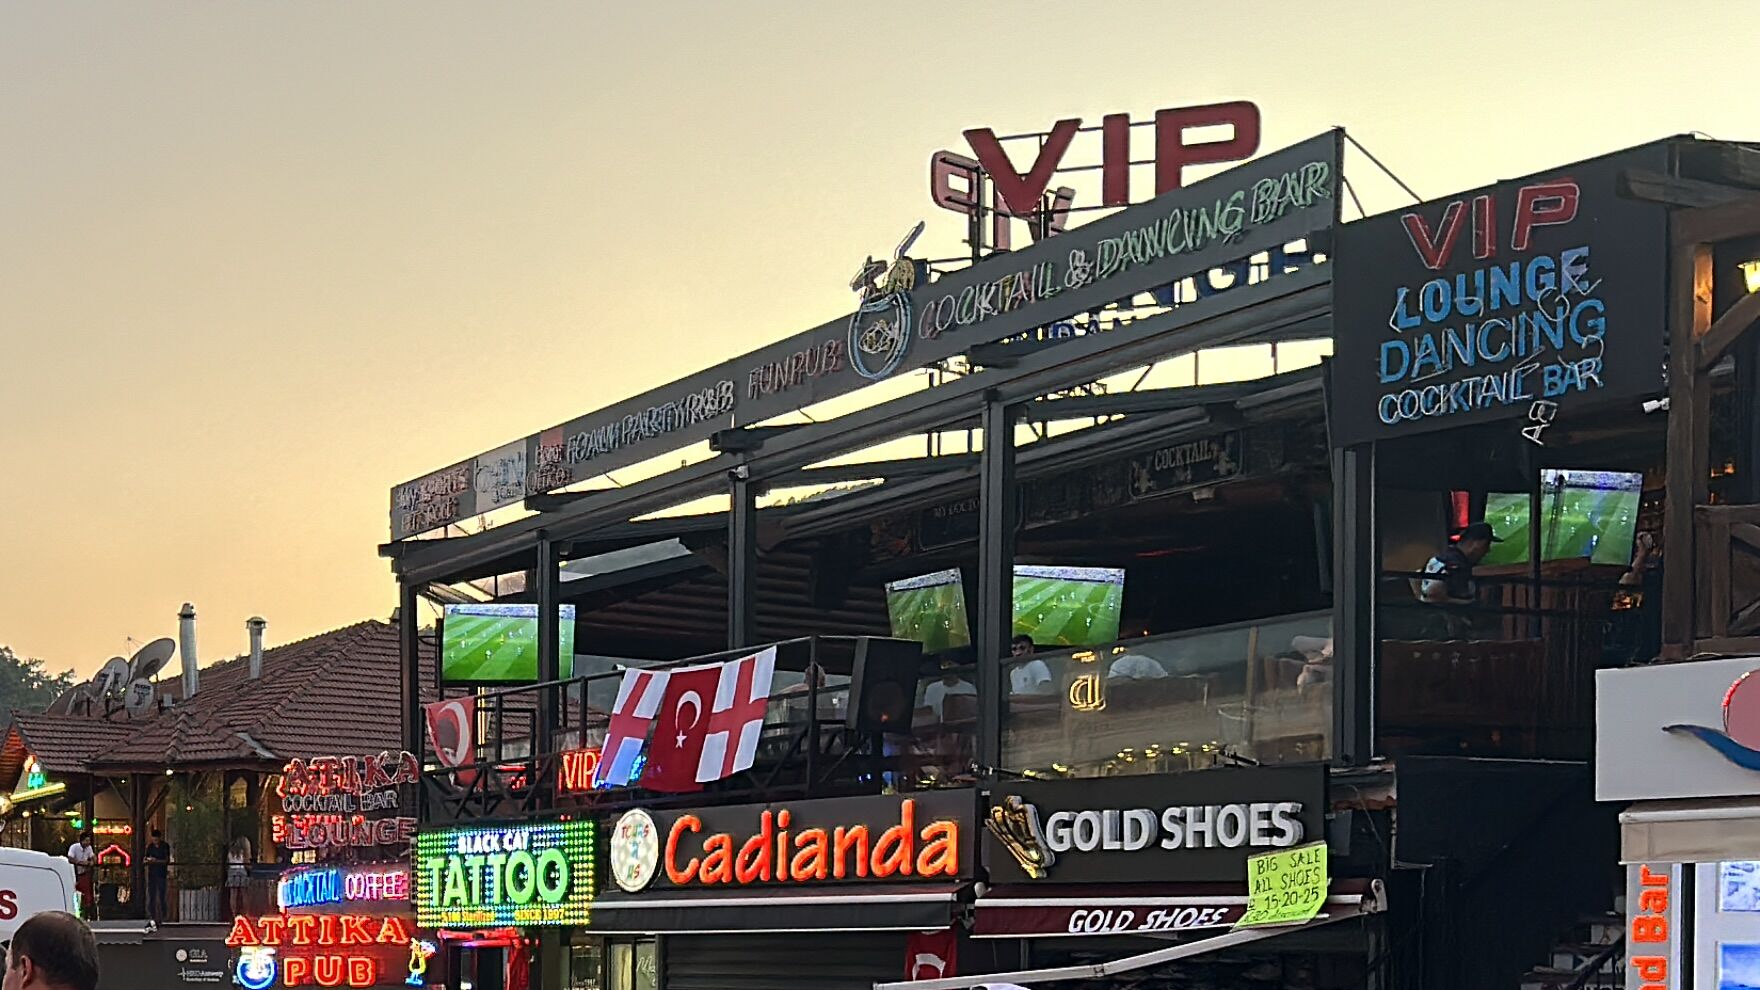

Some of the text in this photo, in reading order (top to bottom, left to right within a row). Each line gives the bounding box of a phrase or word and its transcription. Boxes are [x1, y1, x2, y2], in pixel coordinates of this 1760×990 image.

[963, 100, 1261, 214] VIP
[1401, 176, 1580, 269] VIP
[918, 261, 1062, 340] COCKTAIL
[1065, 249, 1095, 288] &
[1095, 189, 1245, 280] DANCING
[1251, 160, 1333, 225] BAR
[1393, 246, 1592, 333] LOUNGE
[1378, 299, 1607, 384] DANCING
[1378, 357, 1604, 425] COCKTAIL BAR
[562, 753, 598, 790] VIP
[282, 790, 399, 812] COCKTAIL BAR
[285, 816, 418, 849] LOUNGE
[457, 831, 530, 853] BLACK CAT
[664, 799, 960, 885] Cadianda
[1045, 802, 1303, 852] GOLD SHOES
[425, 848, 570, 907] TATTOO
[1254, 867, 1321, 895] ALL SHOES
[1256, 848, 1321, 875] BIG SALE
[345, 871, 409, 900] COFFEE
[1631, 863, 1670, 943] Bar
[225, 915, 409, 946] ATTIKA
[1068, 907, 1229, 933] GOLD SHOES
[283, 956, 376, 988] PUB
